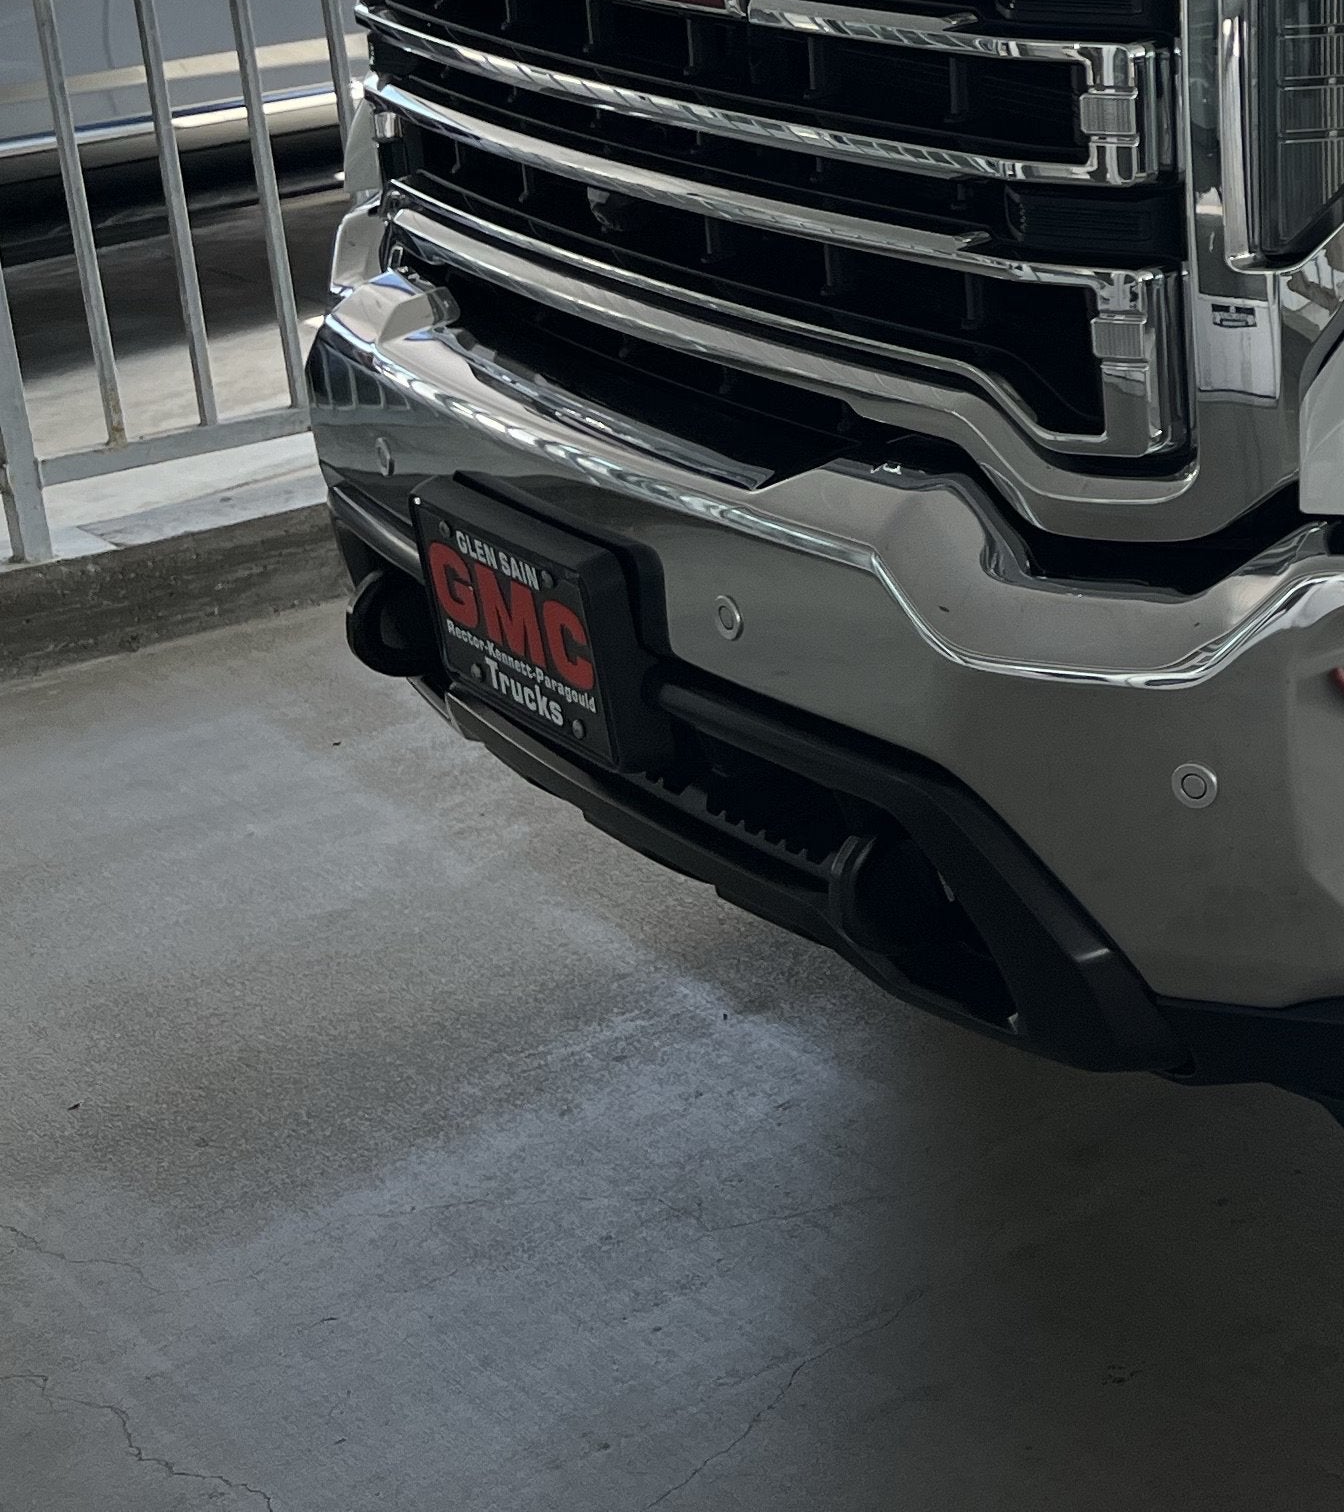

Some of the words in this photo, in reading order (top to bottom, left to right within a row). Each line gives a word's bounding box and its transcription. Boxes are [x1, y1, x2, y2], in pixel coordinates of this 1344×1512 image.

[455, 530, 499, 570] GLEN
[498, 551, 540, 591] SAIN
[428, 540, 595, 691] GMC
[484, 656, 564, 727] Trucks
